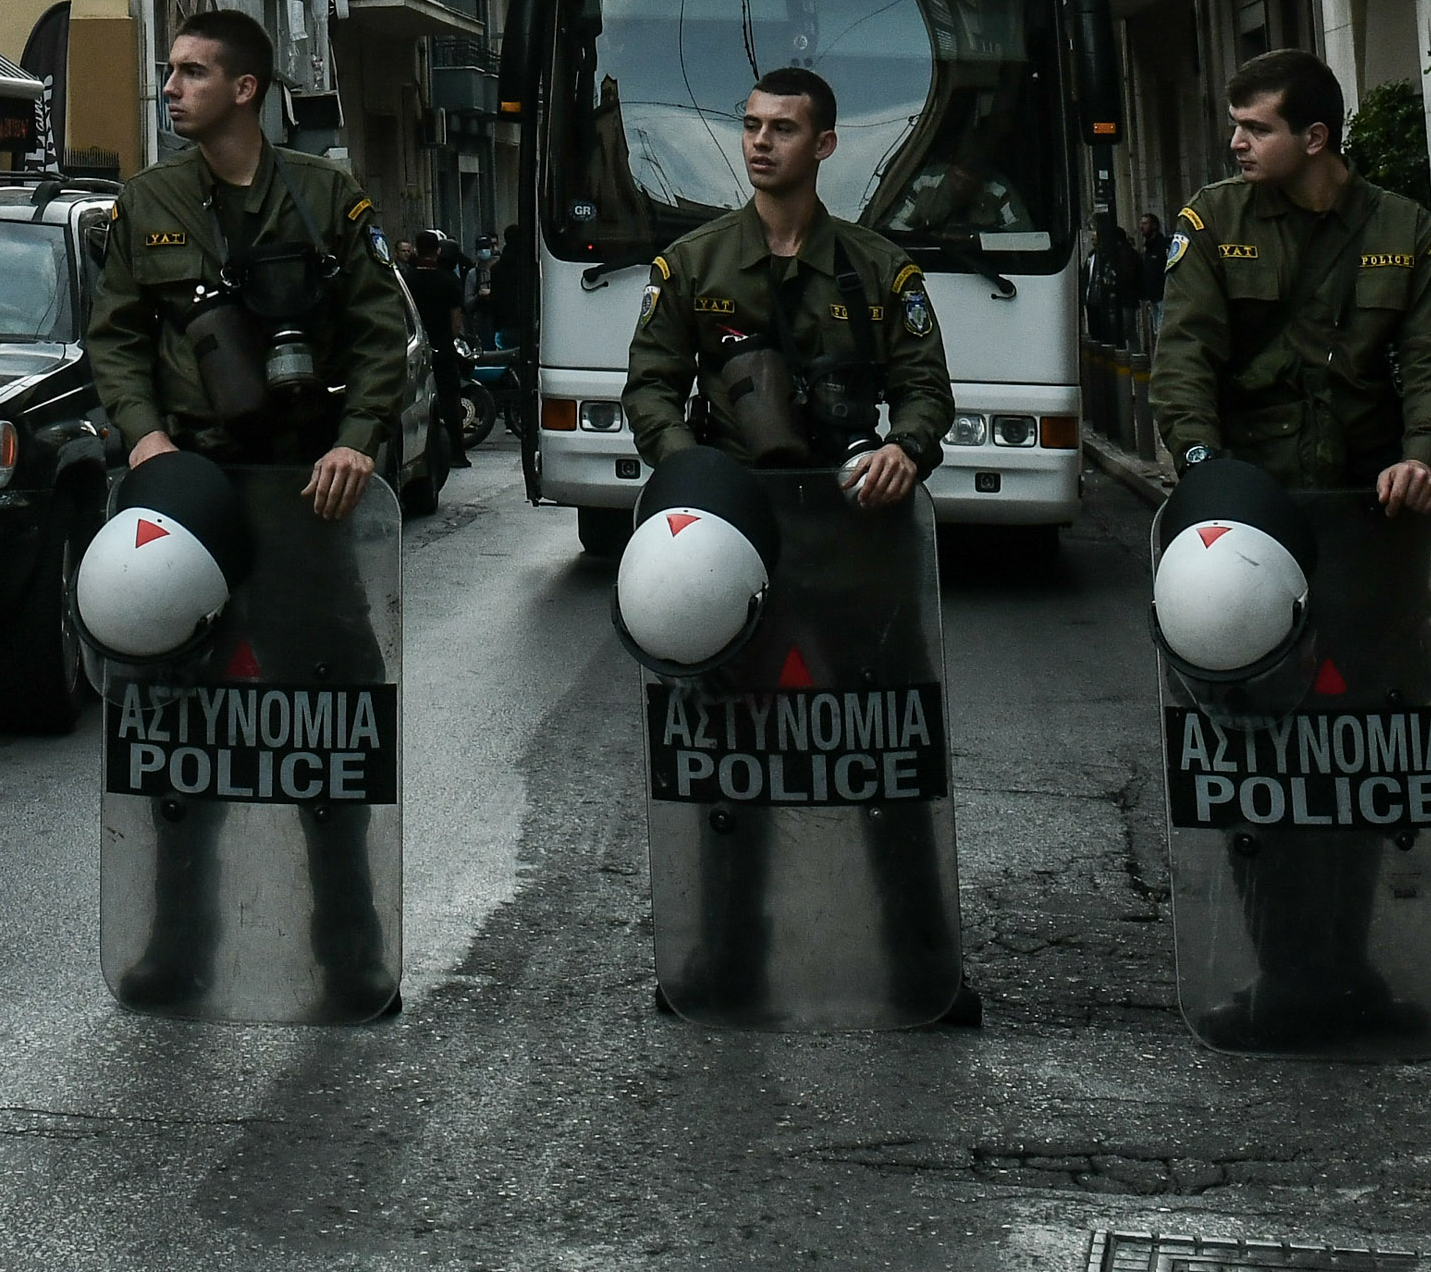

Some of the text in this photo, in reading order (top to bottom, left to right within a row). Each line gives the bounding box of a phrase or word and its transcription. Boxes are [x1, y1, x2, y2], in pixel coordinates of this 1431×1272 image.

[574, 205, 591, 215] GR
[1361, 255, 1411, 267] POLICE
[118, 684, 381, 750] ΑΣΤΥΝΟΜΙΑ
[663, 687, 931, 751] ΑΣΤΥΝΟΜΙΑ
[129, 743, 366, 799] POLICE
[676, 750, 921, 801] POLICE
